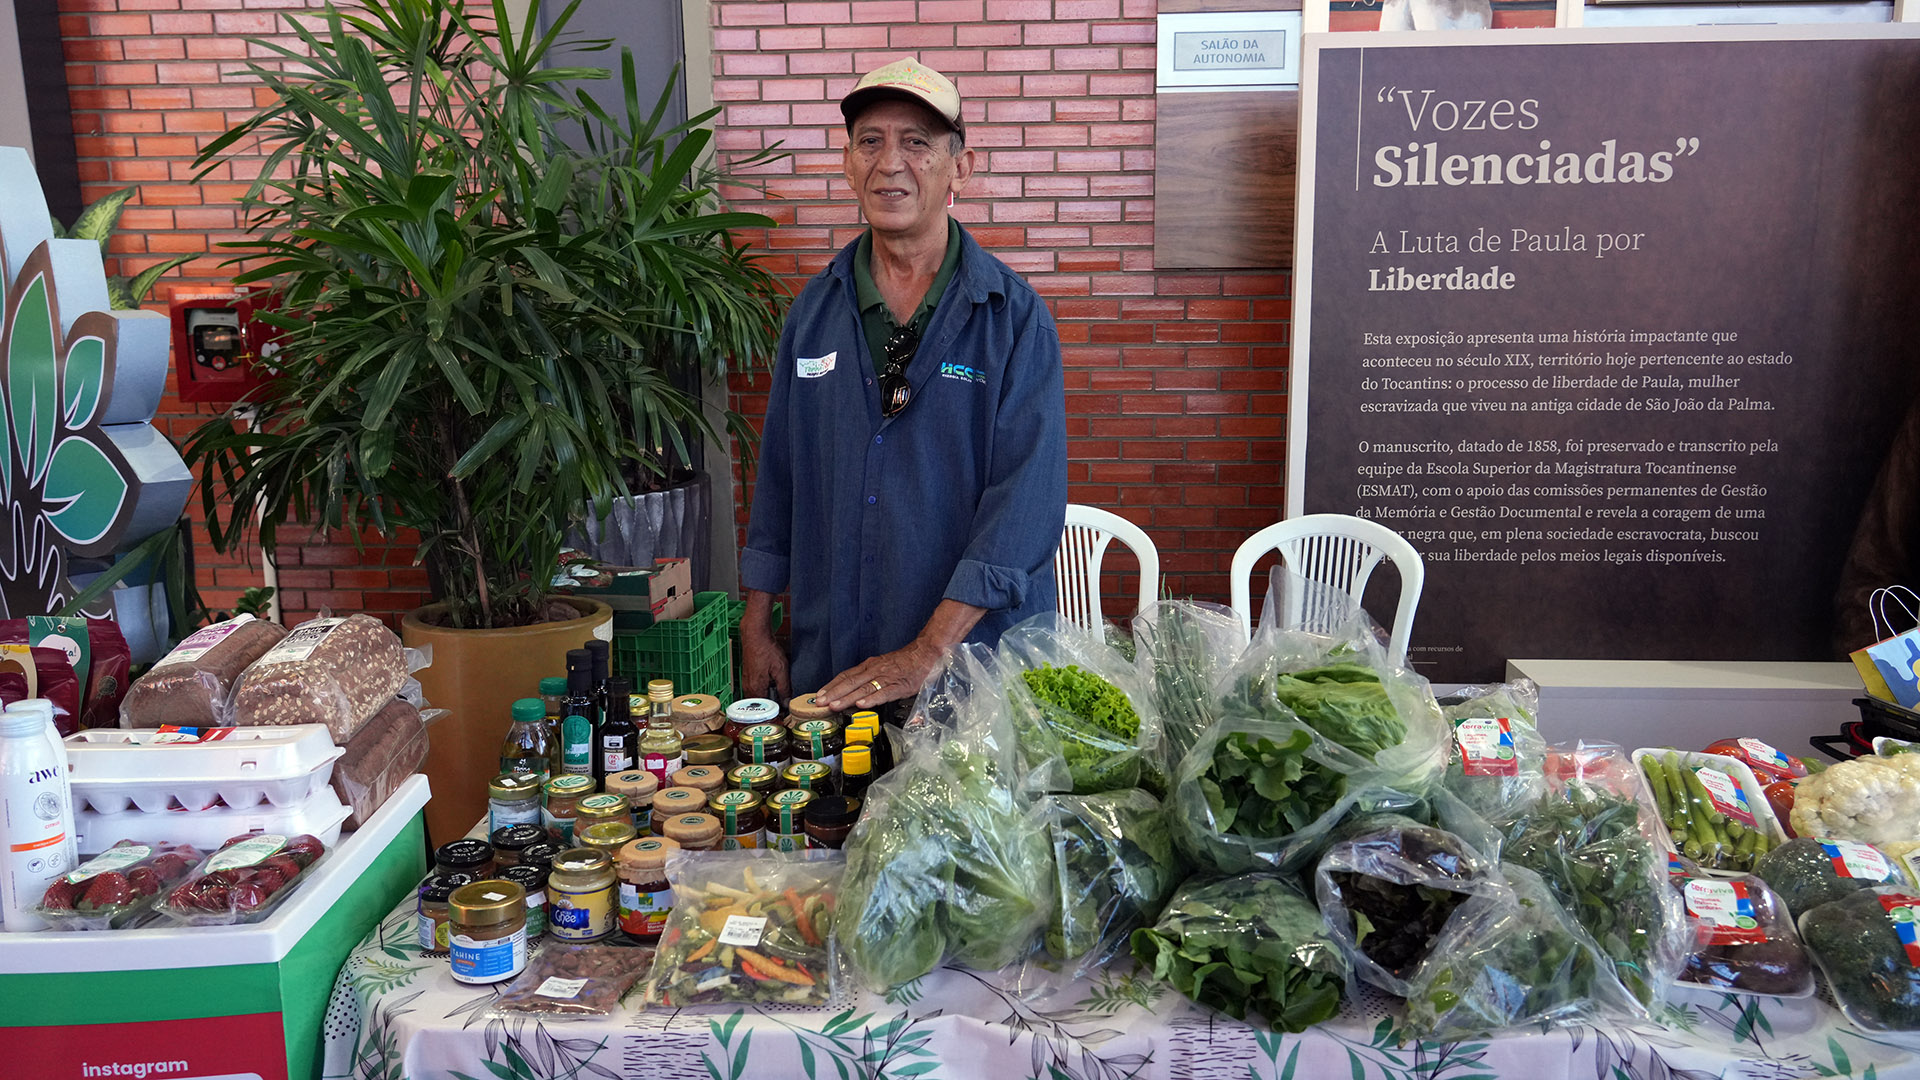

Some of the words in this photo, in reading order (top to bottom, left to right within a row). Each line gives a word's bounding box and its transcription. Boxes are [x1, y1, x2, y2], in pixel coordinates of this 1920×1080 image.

[1201, 38, 1239, 50] SALÃO
[1243, 39, 1259, 49] DA
[1193, 53, 1266, 64] AUTONOMIA
[1369, 230, 1390, 254] A
[1398, 230, 1460, 254] Luta
[1468, 227, 1501, 253] de
[1510, 226, 1587, 252] Paula
[1595, 231, 1645, 259] por
[1368, 265, 1516, 291] Liberdade
[1364, 332, 1393, 346] Esta
[1396, 331, 1465, 349] exposição
[1467, 332, 1536, 348] apresenta
[1538, 333, 1570, 344] uma
[1573, 329, 1627, 344] história
[1630, 329, 1709, 347] impactante
[1712, 332, 1739, 346] que
[1363, 356, 1433, 368] aconteceu
[1436, 357, 1454, 368] no
[1457, 353, 1502, 367] século
[1504, 353, 1535, 370] XIX,
[1538, 352, 1603, 367] território
[1606, 352, 1637, 370] hoje
[1640, 353, 1725, 369] pertencente
[1727, 355, 1745, 366] ao
[1748, 351, 1794, 366] estado
[1361, 377, 1379, 391] do
[1381, 376, 1453, 390] Tocantins:
[1456, 379, 1466, 390] o
[1468, 379, 1530, 393] processo
[1532, 375, 1550, 389] de
[1552, 375, 1619, 389] liberdade
[1621, 375, 1639, 389] de
[1642, 374, 1685, 392] Paula,
[1688, 374, 1742, 389] mulher
[1360, 399, 1440, 413] escravizada
[1442, 402, 1468, 416] que
[1471, 398, 1508, 412] viveu
[1511, 401, 1529, 412] na
[1531, 398, 1574, 415] antiga
[1577, 397, 1623, 412] cidade
[1625, 397, 1643, 412] de
[1646, 397, 1671, 412] São
[1672, 397, 1705, 414] João
[1707, 397, 1725, 411] da
[1728, 397, 1776, 411] Palma.
[1359, 440, 1370, 454] O
[1373, 439, 1454, 456] manuscrito,
[1458, 439, 1504, 453] datado
[1507, 439, 1524, 453] de
[1528, 440, 1562, 456] 1858,
[1565, 438, 1584, 453] foi
[1587, 439, 1665, 456] preservado
[1667, 442, 1676, 453] e
[1679, 439, 1747, 453] transcrito
[1750, 439, 1780, 456] pela
[1358, 462, 1404, 479] equipe
[1407, 461, 1424, 476] da
[1426, 461, 1471, 475] Escola
[1473, 461, 1533, 479] Superior
[1535, 461, 1552, 475] da
[1554, 461, 1643, 478] Magistratura
[1645, 461, 1738, 475] Tocantinense
[1357, 483, 1419, 500] (ESMAT),
[1422, 487, 1452, 497] com
[1455, 487, 1464, 497] o
[1467, 483, 1505, 501] apoio
[1508, 483, 1531, 497] das
[1534, 483, 1604, 497] comissões
[1607, 485, 1698, 500] permanentes
[1701, 483, 1718, 497] de
[1721, 483, 1768, 497] Gestão
[1355, 505, 1372, 519] da
[1375, 505, 1437, 519] Memória
[1440, 509, 1448, 519] e
[1451, 505, 1497, 519] Gestão
[1499, 505, 1582, 519] Documental
[1585, 509, 1594, 519] e
[1597, 505, 1639, 519] revela
[1641, 509, 1650, 519] a
[1652, 509, 1712, 523] coragem
[1715, 506, 1733, 519] de
[1736, 509, 1767, 520] uma
[1407, 529, 1447, 543] negra
[1449, 530, 1478, 544] que,
[1481, 530, 1503, 540] em
[1506, 527, 1544, 544] plena
[1546, 527, 1615, 541] sociedade
[1617, 529, 1707, 544] escravocrata,
[1710, 527, 1760, 541] buscou
[1428, 552, 1451, 562] sua
[1455, 548, 1518, 562] liberdade
[1522, 548, 1557, 565] pelos
[1561, 552, 1601, 562] meios
[1605, 549, 1643, 566] legais
[1646, 549, 1727, 566] disponíveis.
[555, 909, 577, 925] Ghee
[82, 1058, 189, 1079] instagram
